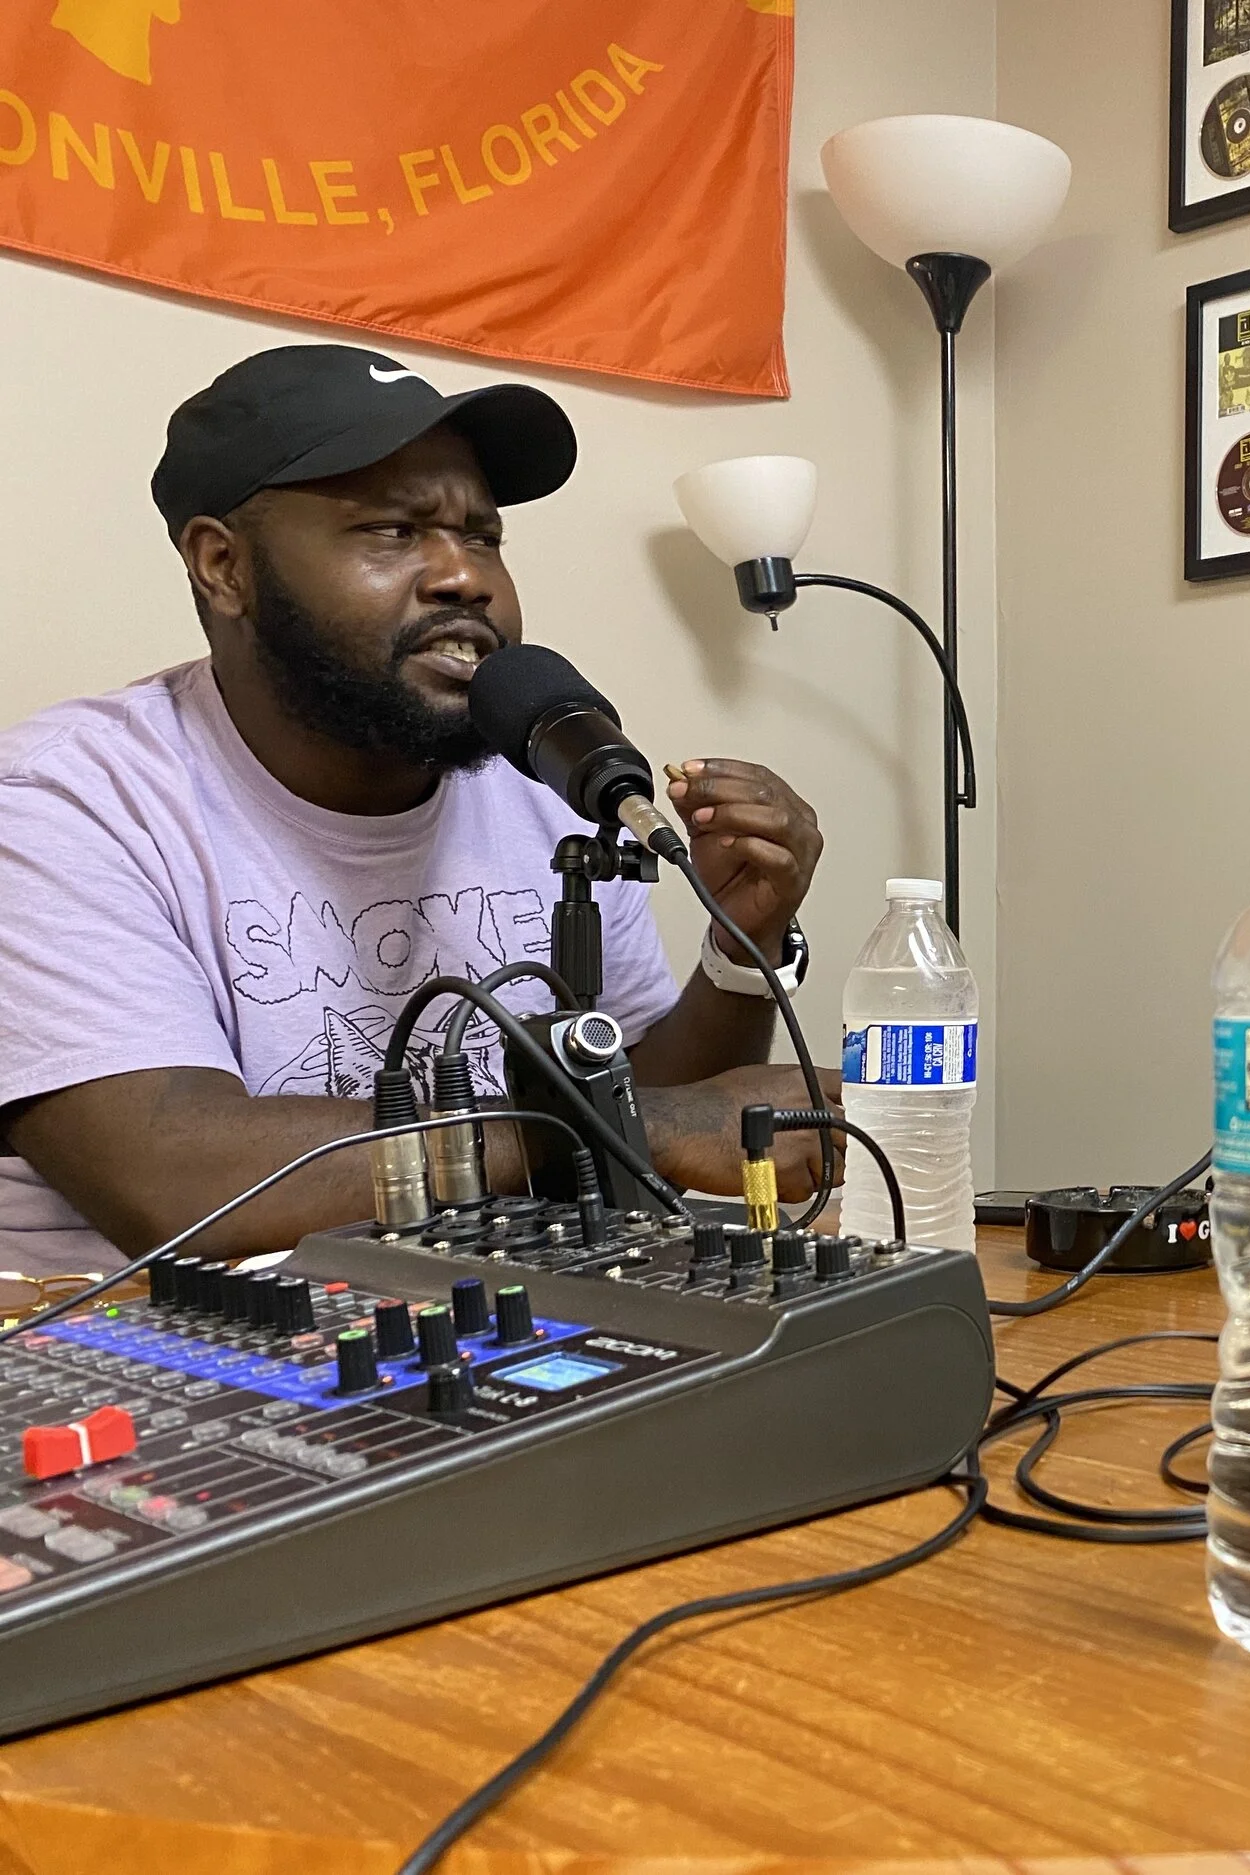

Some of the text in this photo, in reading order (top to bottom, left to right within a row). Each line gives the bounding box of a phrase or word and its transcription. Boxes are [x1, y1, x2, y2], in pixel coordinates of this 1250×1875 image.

[398, 42, 664, 216] FLORIDA
[225, 886, 552, 1005] SMOKE
[629, 1103, 638, 1117] OUT
[1167, 1223, 1178, 1244] I
